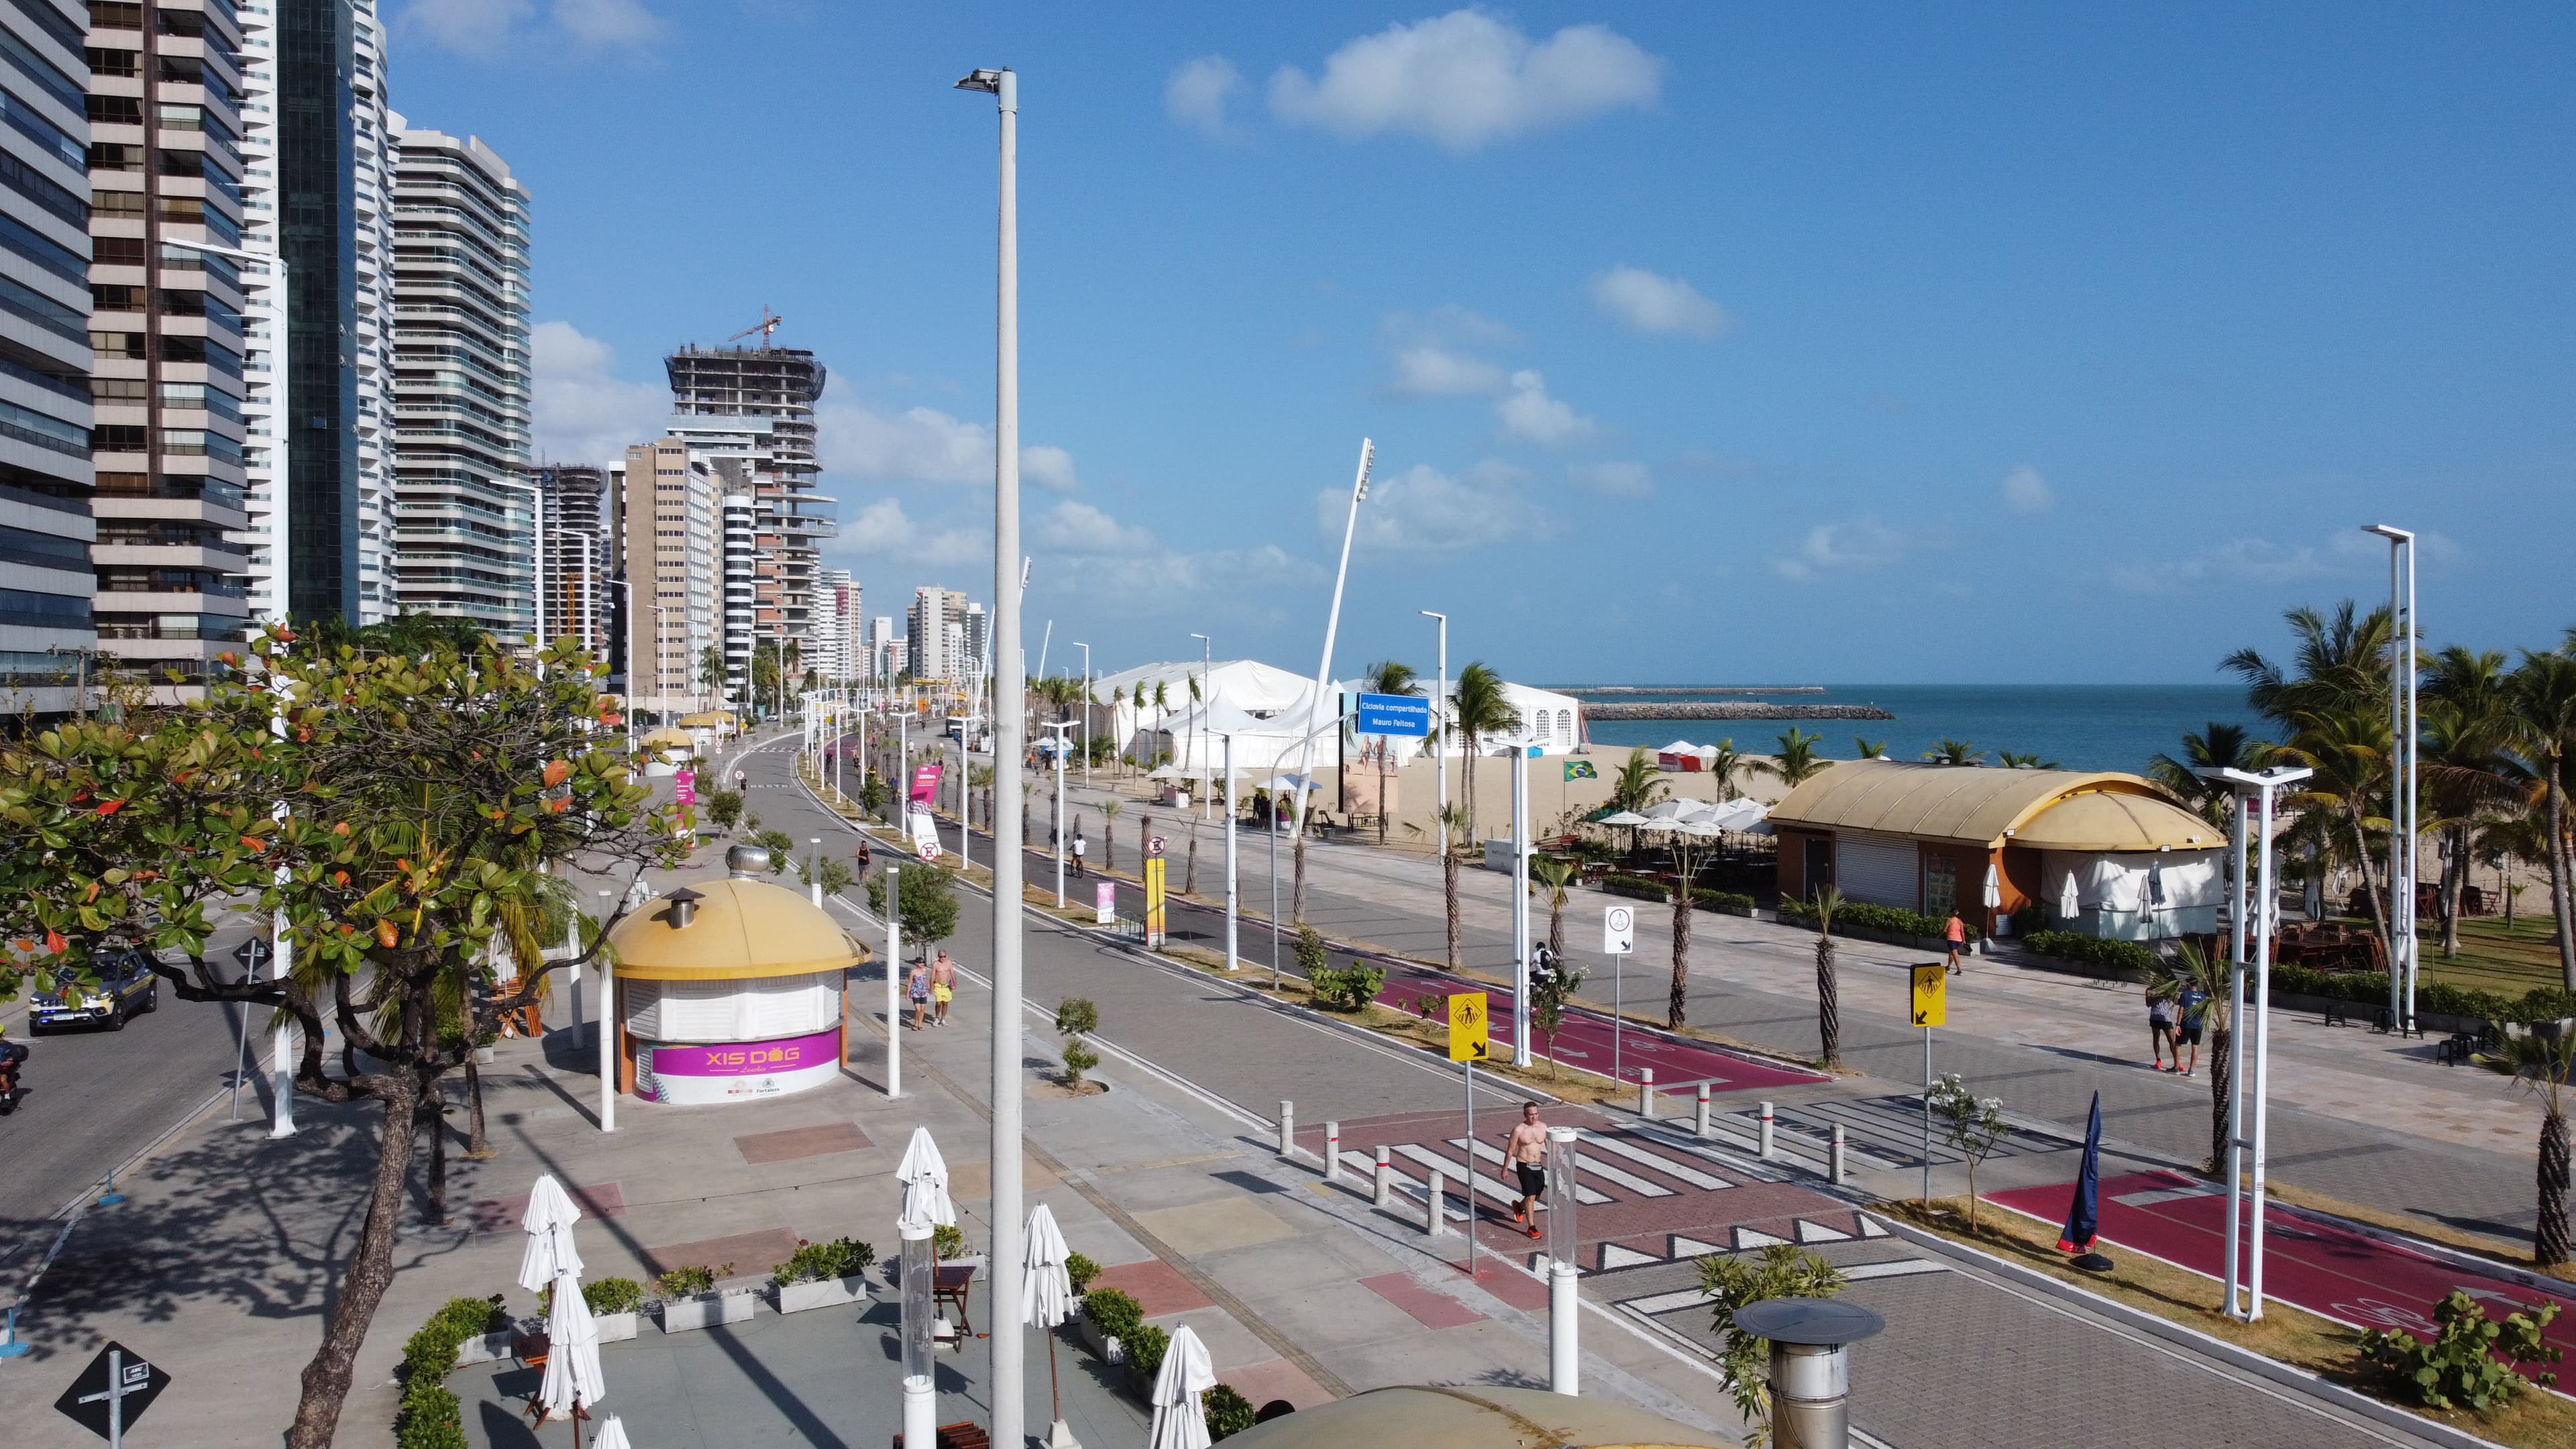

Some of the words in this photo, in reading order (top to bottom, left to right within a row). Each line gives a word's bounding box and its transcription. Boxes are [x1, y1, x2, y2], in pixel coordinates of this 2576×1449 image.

[1362, 702, 1385, 711] Ciclovia
[1386, 705, 1428, 714] compartilhada
[1373, 718, 1392, 726] Mauro
[1393, 719, 1415, 728] Feitosa
[706, 1052, 745, 1065] XIS
[751, 1046, 800, 1064] DOG
